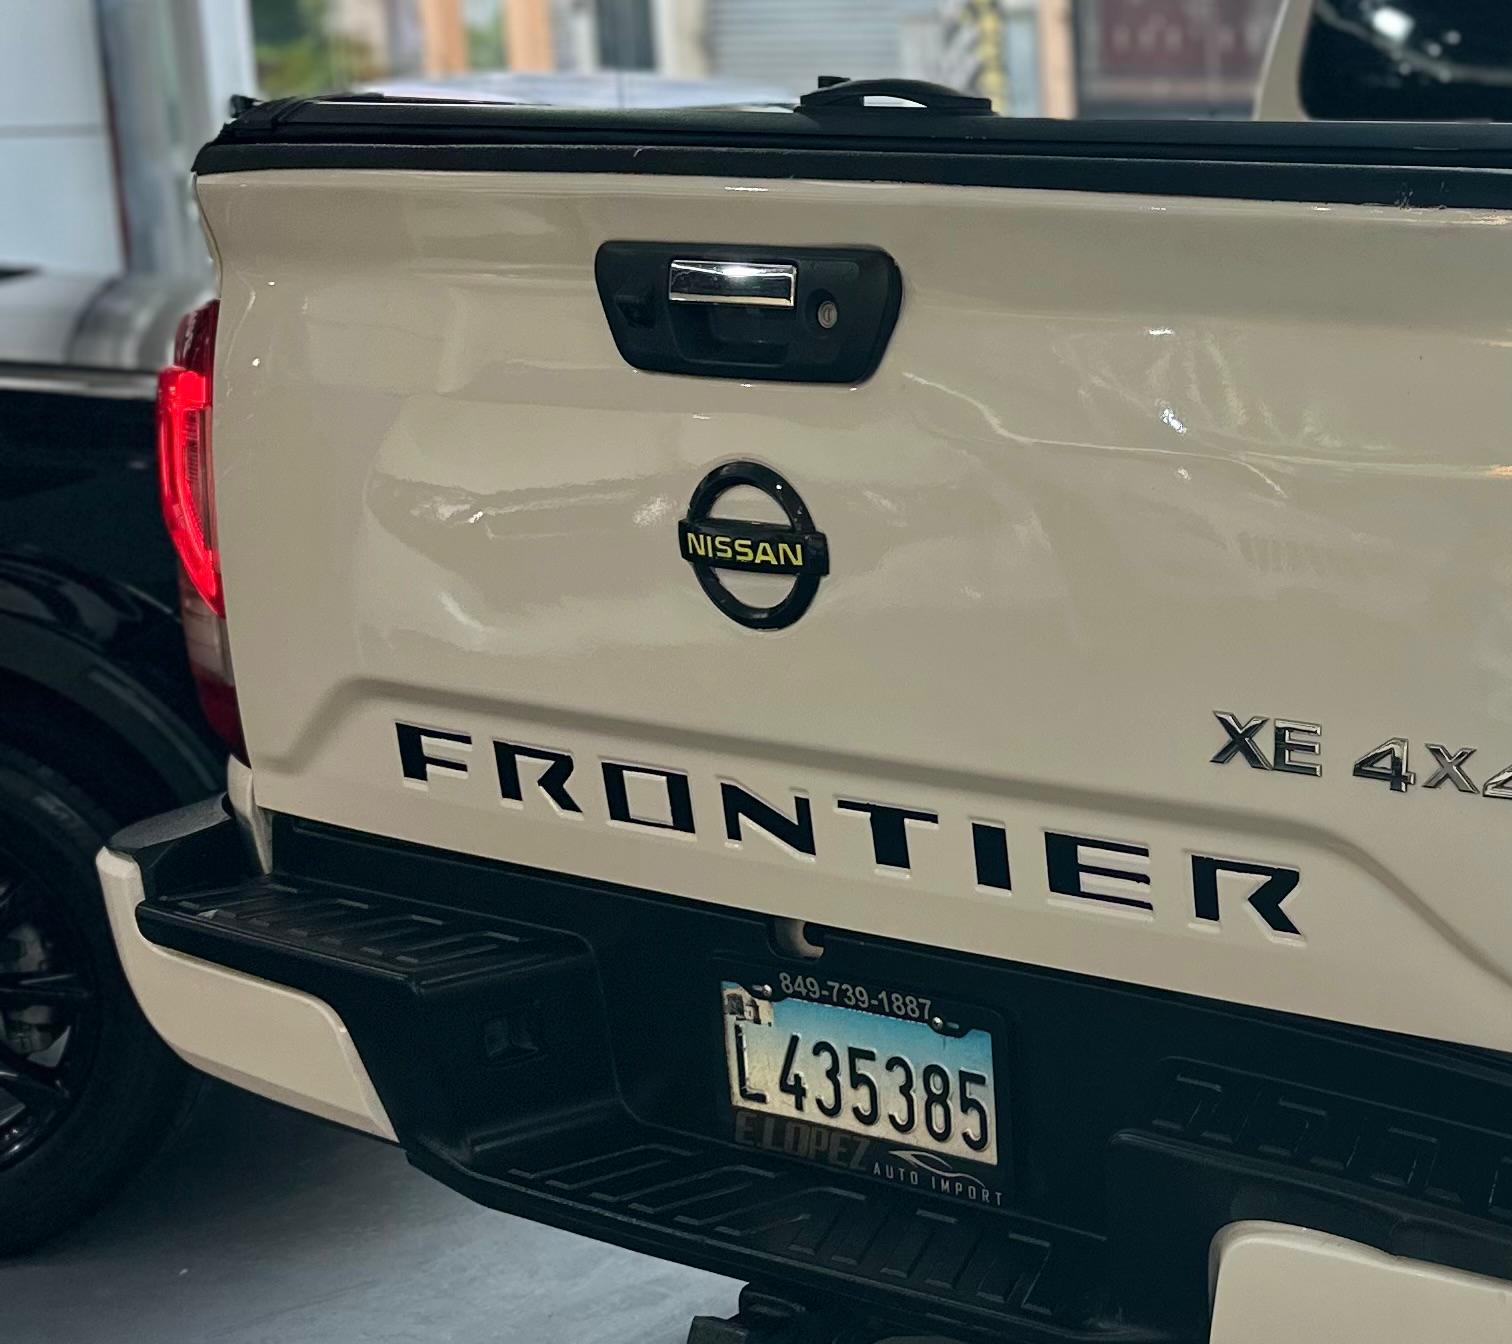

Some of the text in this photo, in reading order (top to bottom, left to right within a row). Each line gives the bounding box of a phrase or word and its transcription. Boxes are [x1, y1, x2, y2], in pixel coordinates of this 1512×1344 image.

[686, 531, 804, 566] NISSAN
[1209, 710, 1323, 778] XE
[394, 720, 1304, 937] FRONTIER
[778, 971, 932, 1020] 849-739-1887
[734, 1023, 990, 1152] L435385
[873, 1161, 1004, 1207] AUTO IMPORT
